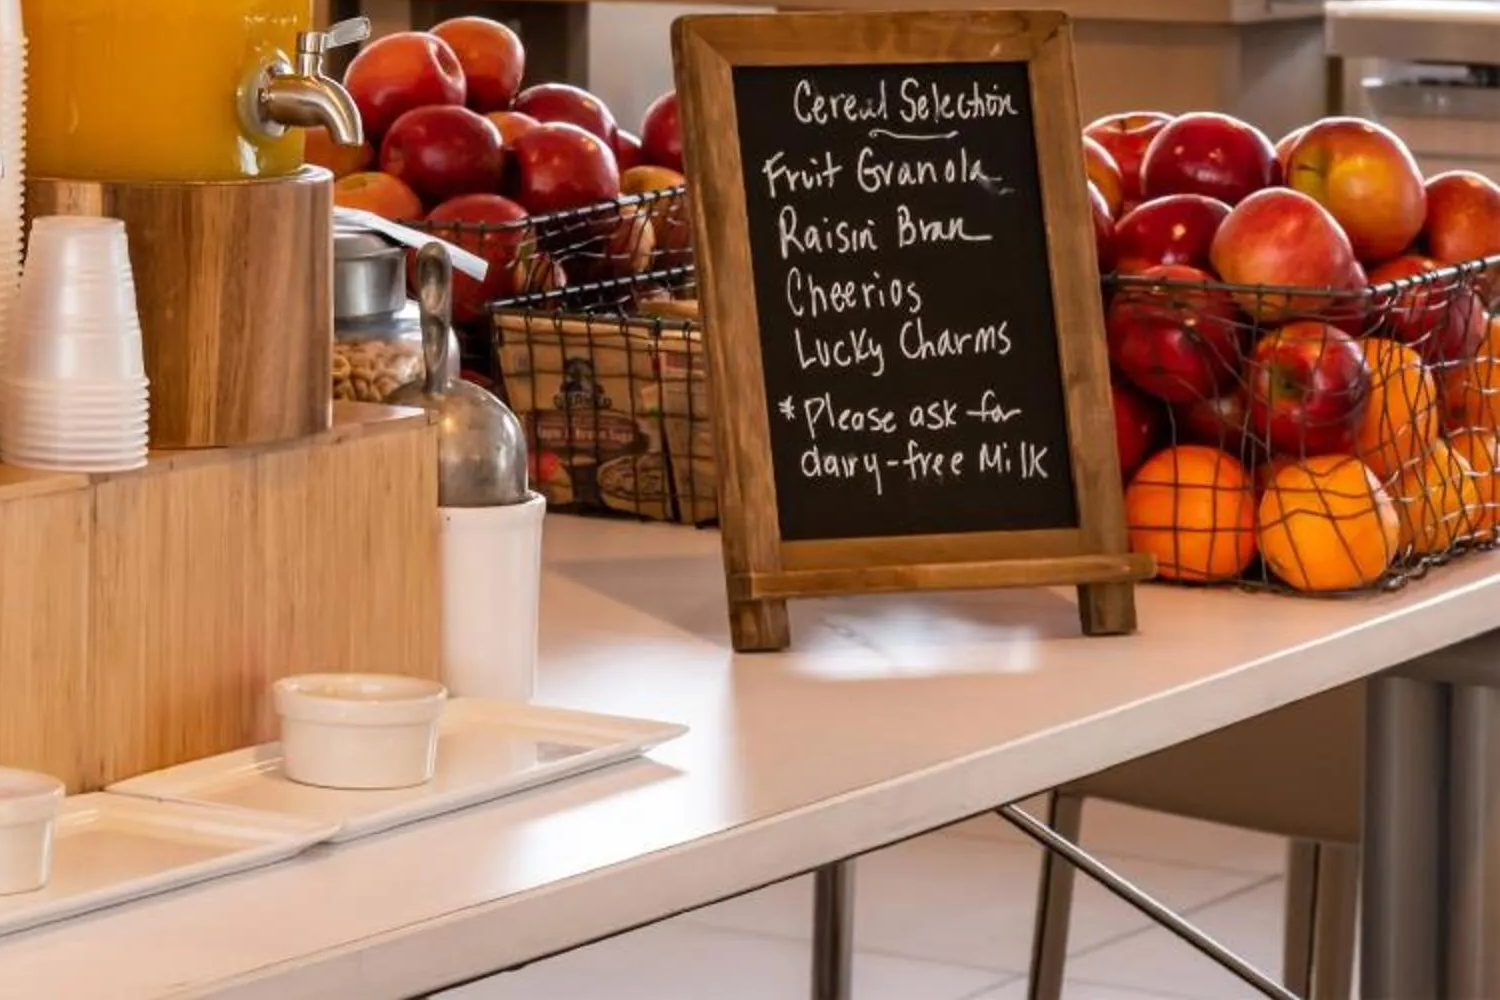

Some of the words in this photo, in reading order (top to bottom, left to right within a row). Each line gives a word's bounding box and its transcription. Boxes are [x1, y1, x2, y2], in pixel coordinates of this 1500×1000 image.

[793, 79, 888, 124] Cereal
[900, 77, 1018, 124] Selection
[762, 152, 843, 198] Fruit
[857, 147, 1004, 193] Granola
[779, 205, 878, 260] Raisin
[897, 205, 993, 248] Bran
[787, 267, 922, 318] Cheerios
[900, 317, 1012, 360] Charms
[909, 400, 958, 429] ask
[966, 390, 1022, 422] for
[801, 439, 963, 495] dairy-free
